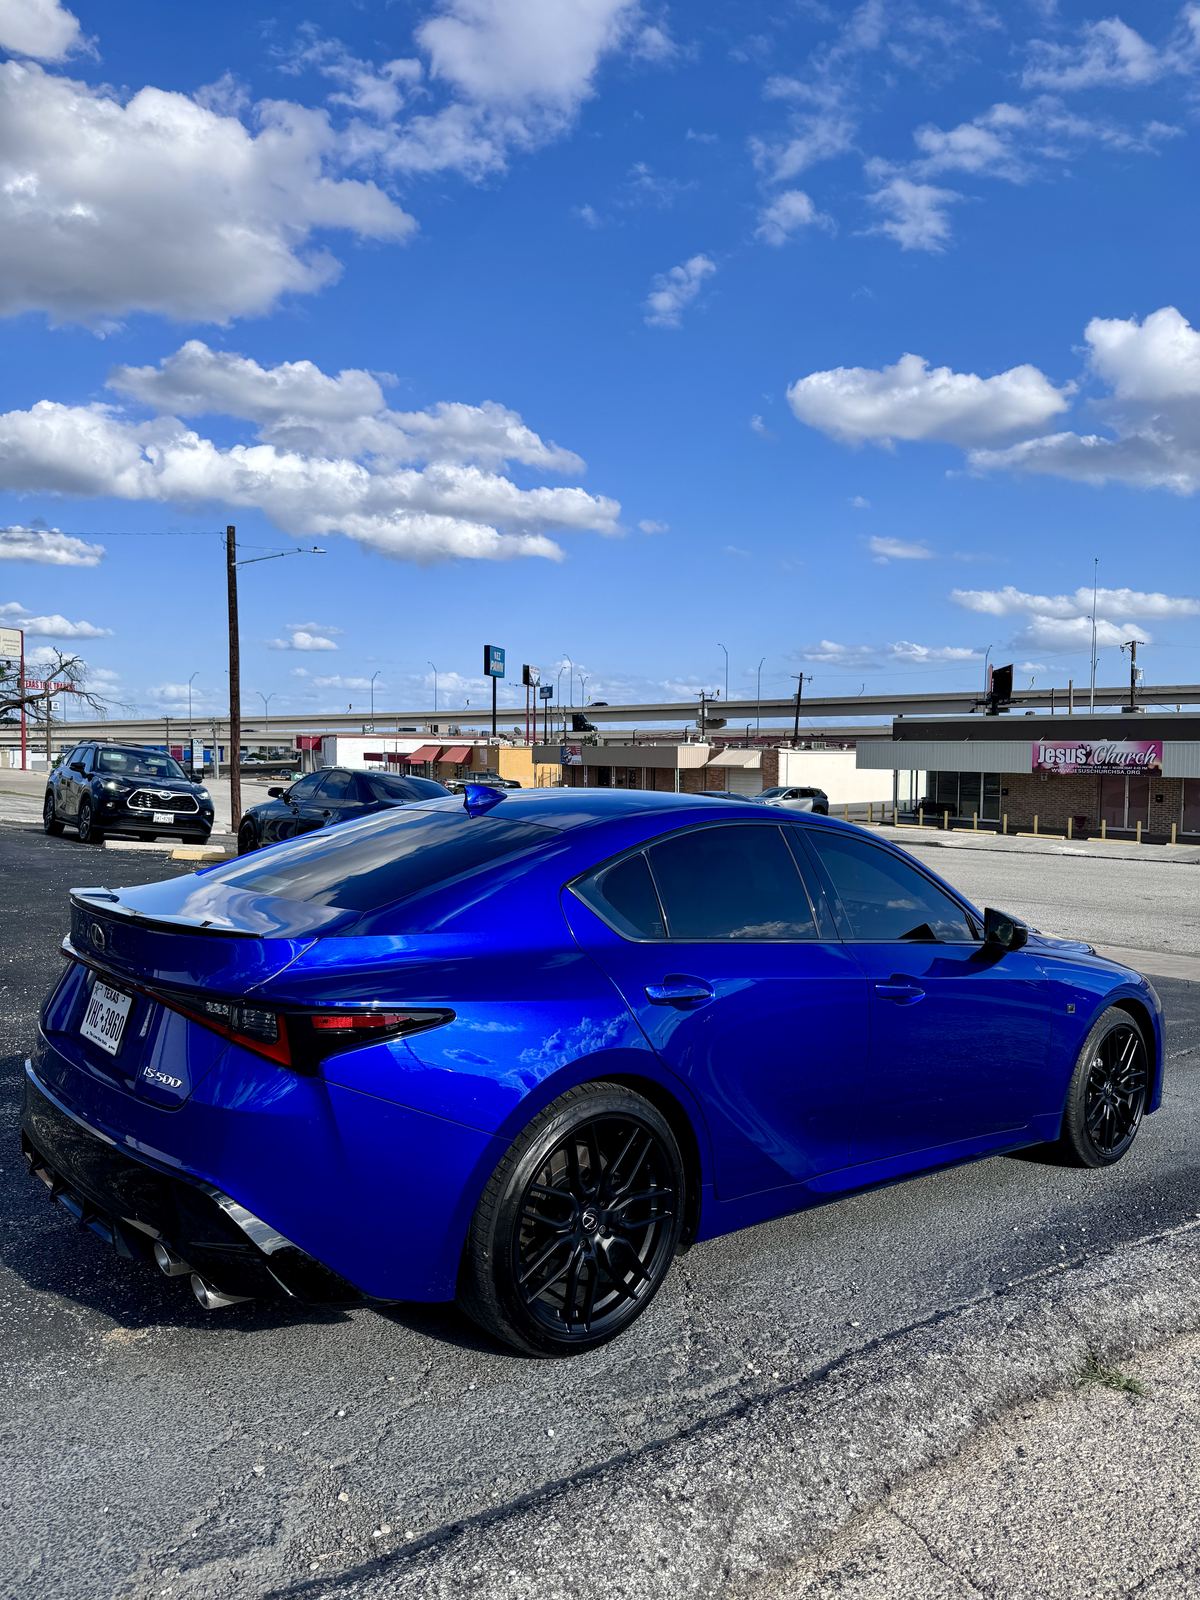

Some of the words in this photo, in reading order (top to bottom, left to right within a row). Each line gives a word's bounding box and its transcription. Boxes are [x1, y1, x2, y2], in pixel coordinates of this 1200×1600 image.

[1037, 744, 1091, 763] Jesus'
[1093, 744, 1156, 765] Church
[104, 986, 120, 1004] TEXAS
[143, 1066, 157, 1078] IS
[156, 1072, 183, 1088] 500
